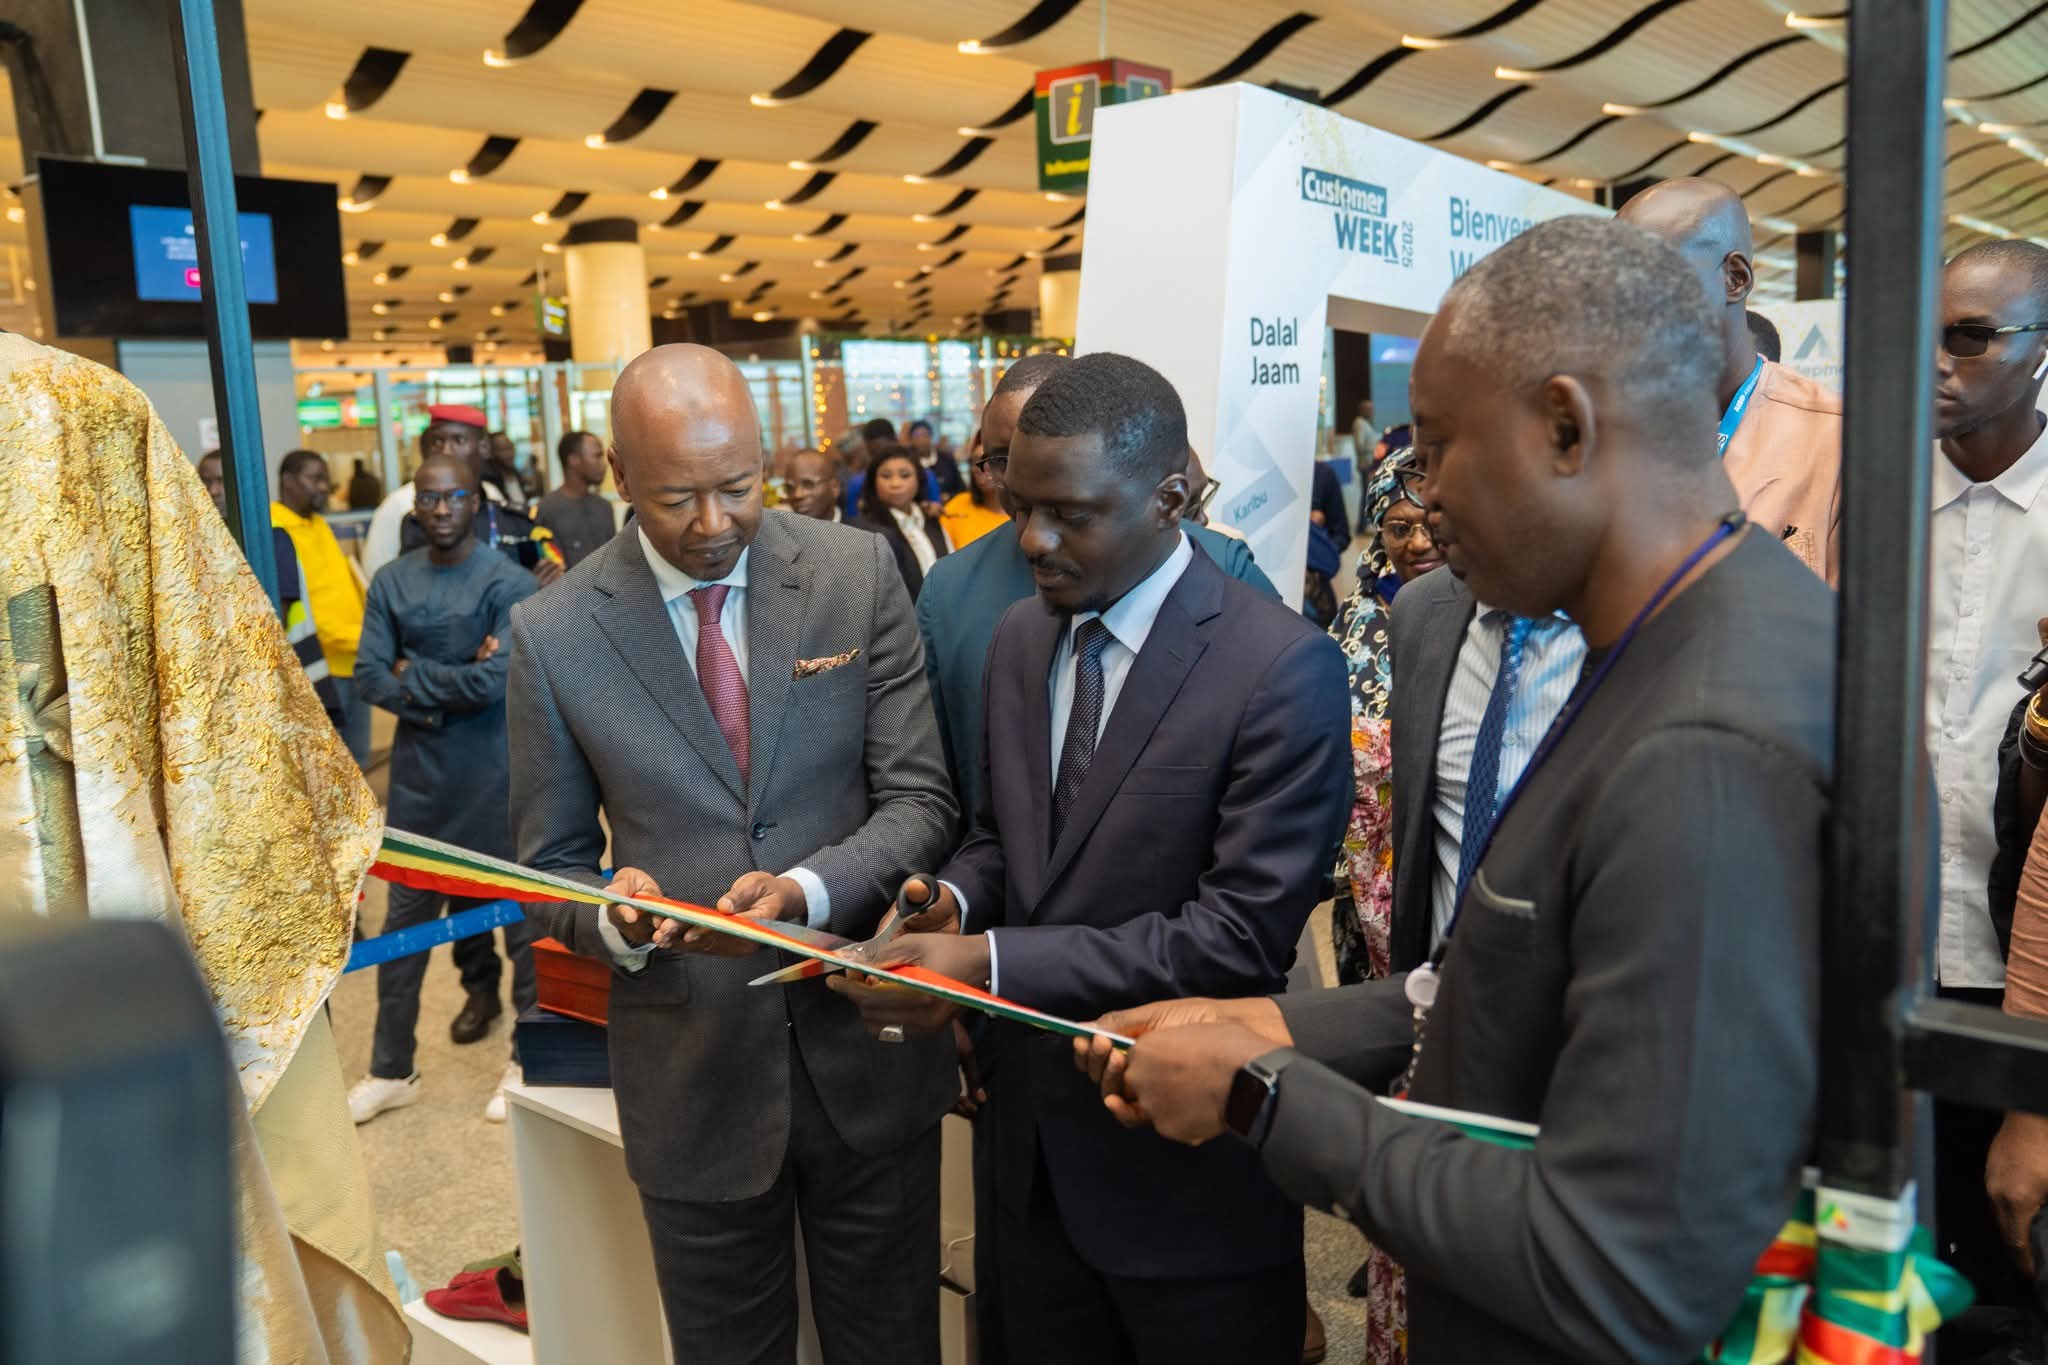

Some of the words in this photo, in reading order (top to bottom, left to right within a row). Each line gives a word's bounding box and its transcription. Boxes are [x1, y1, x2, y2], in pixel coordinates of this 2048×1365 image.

[1304, 171, 1385, 215] Customer
[1334, 211, 1399, 259] WEEK
[1250, 316, 1298, 347] Dalal
[1251, 356, 1300, 385] Jaam
